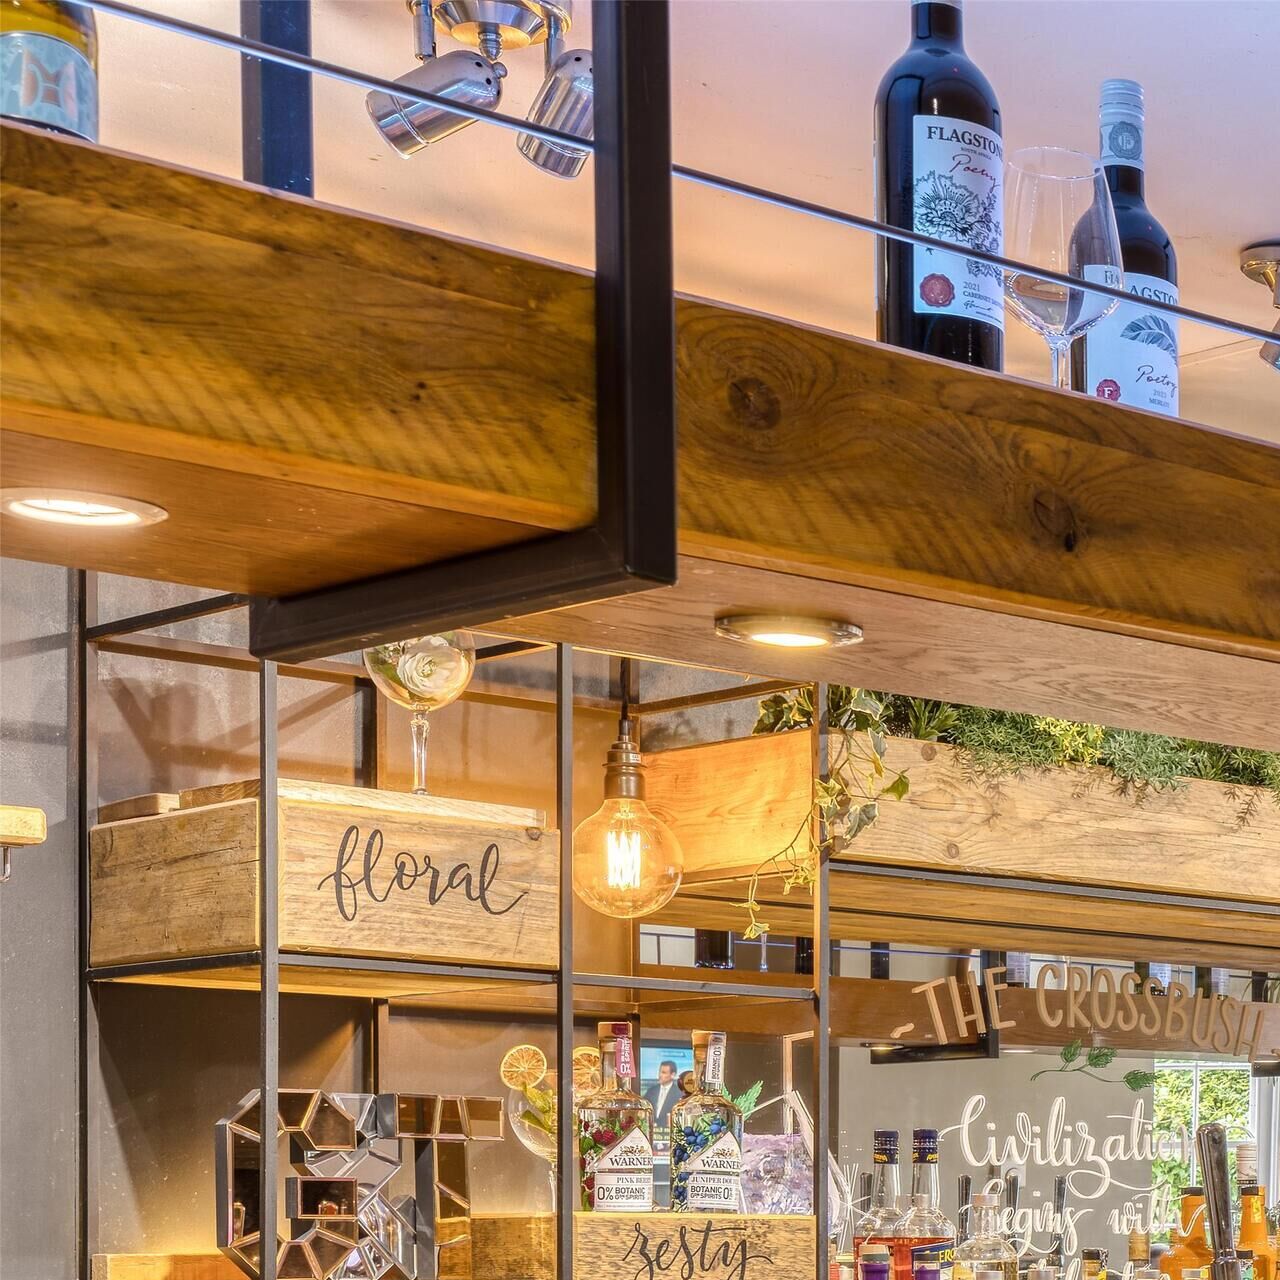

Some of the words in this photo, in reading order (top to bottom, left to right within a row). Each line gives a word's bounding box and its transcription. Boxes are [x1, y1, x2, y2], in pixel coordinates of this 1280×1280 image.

[963, 281, 980, 291] 2021
[317, 825, 529, 921] floral
[912, 966, 1016, 1045] THE
[1037, 963, 1264, 1063] CROSSBUSH
[691, 1176, 721, 1184] JUNIPER
[597, 1186, 614, 1200] 0%
[690, 1186, 722, 1194] BOTANIC
